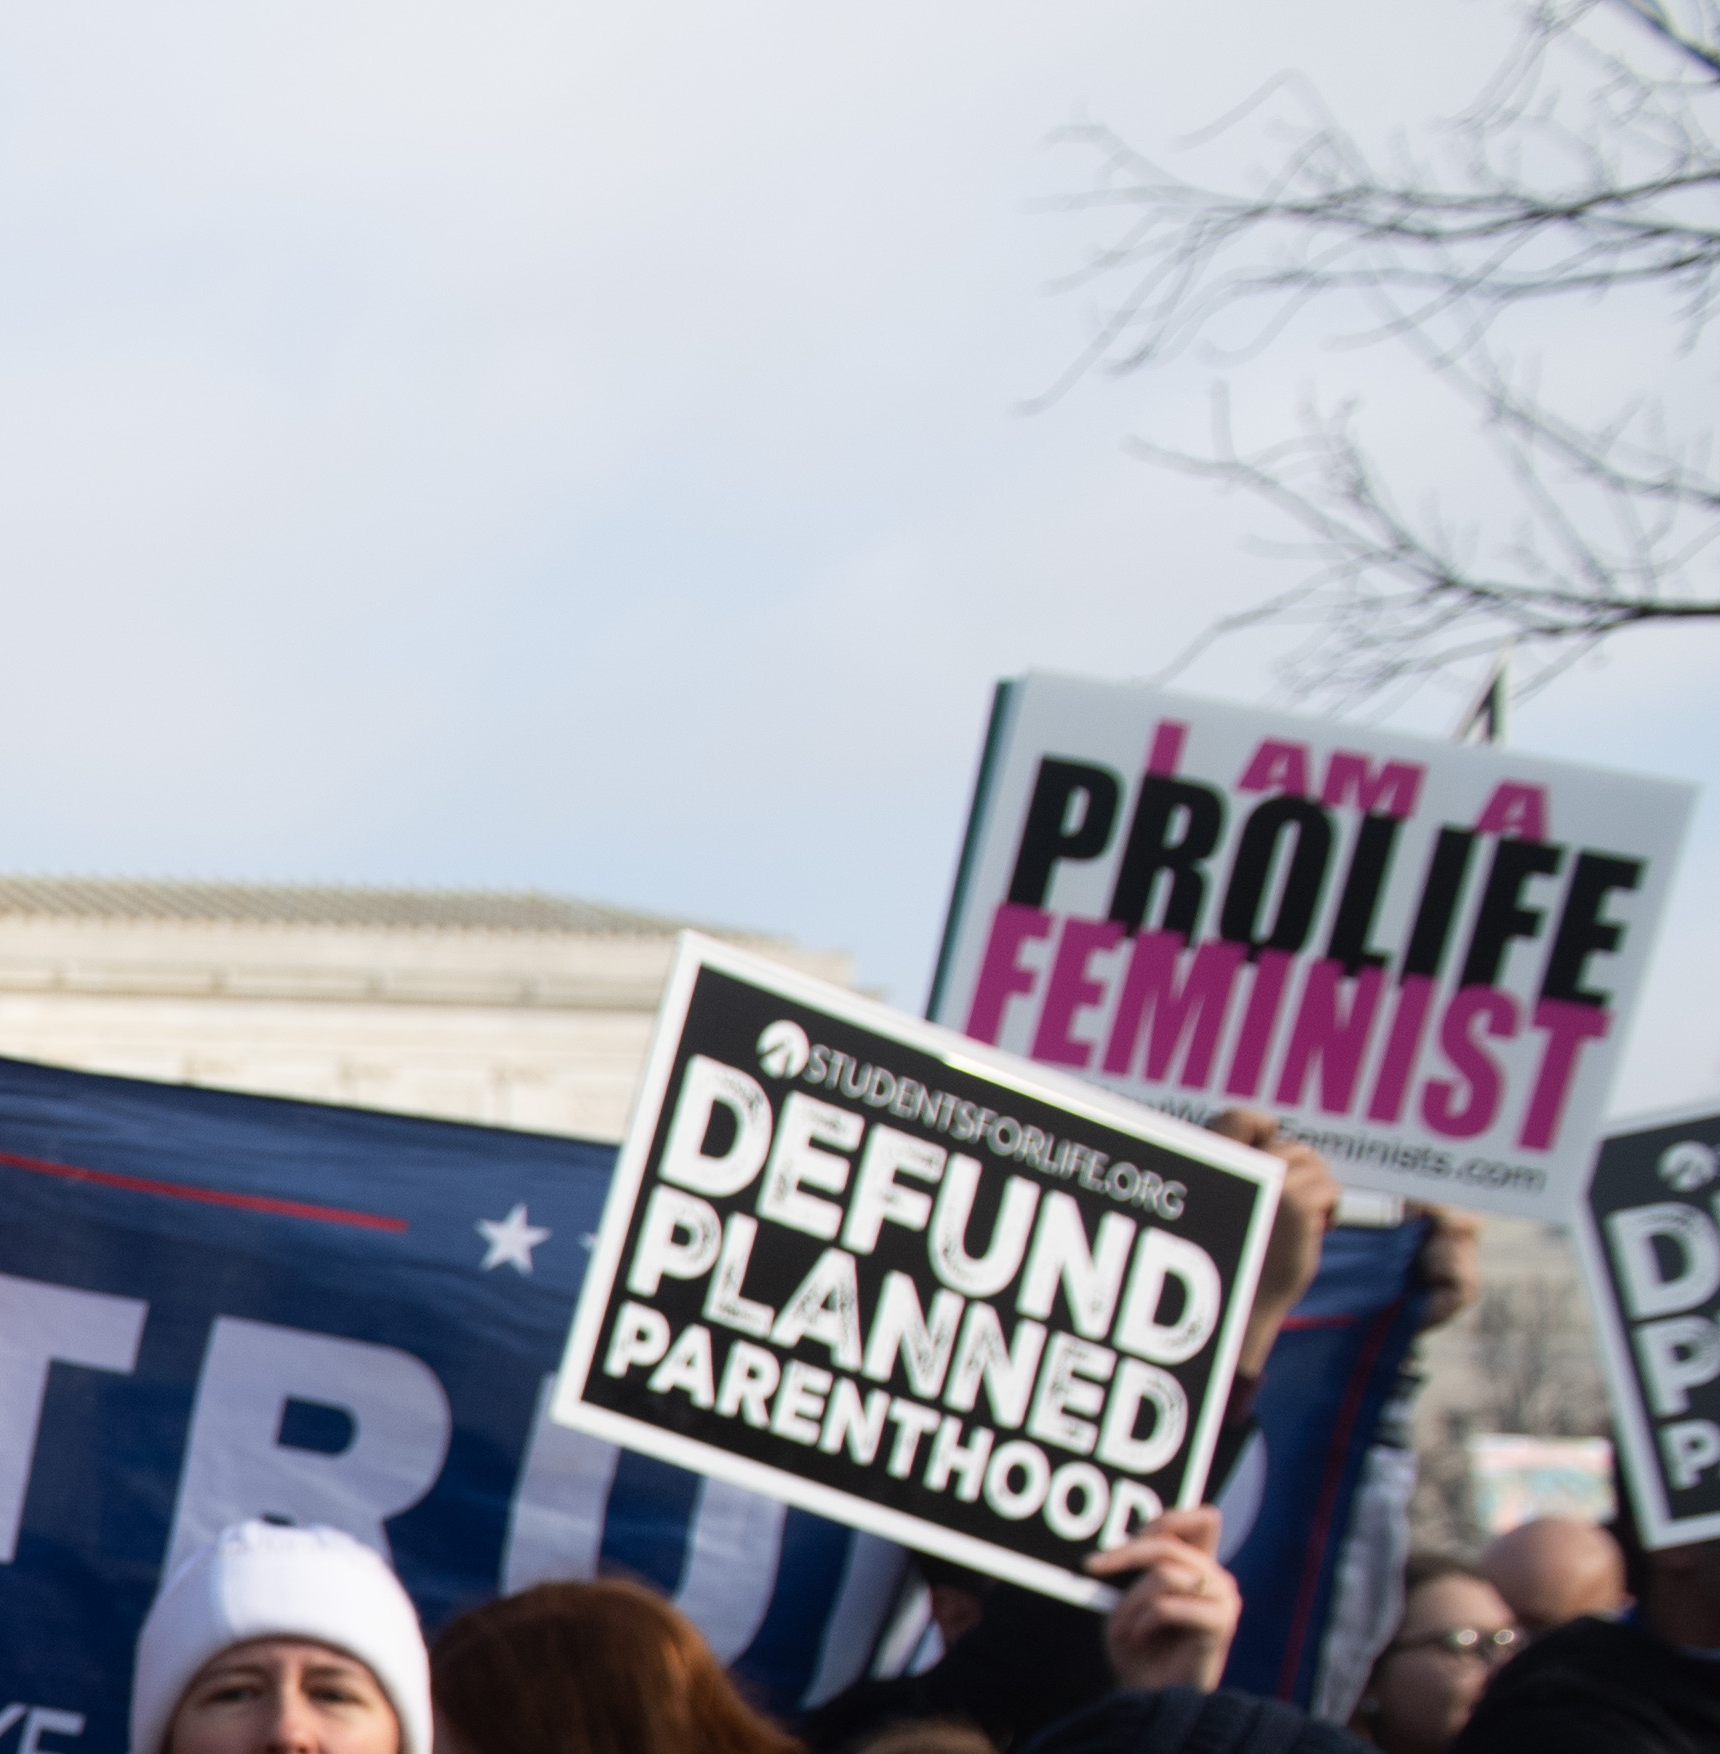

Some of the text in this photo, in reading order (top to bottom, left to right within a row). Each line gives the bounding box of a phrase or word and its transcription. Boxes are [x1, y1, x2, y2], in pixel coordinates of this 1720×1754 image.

[1006, 752, 1647, 1010] PROLIFE
[1144, 719, 1550, 842] I AM A
[802, 1044, 1186, 1221] STUDENTSFORLIFE.ORG
[961, 902, 1615, 1155] FEMINIST
[626, 1185, 1191, 1476] PLANNED
[659, 1054, 1222, 1366] DEFUND
[603, 1300, 1163, 1552] PARENTHOOD
